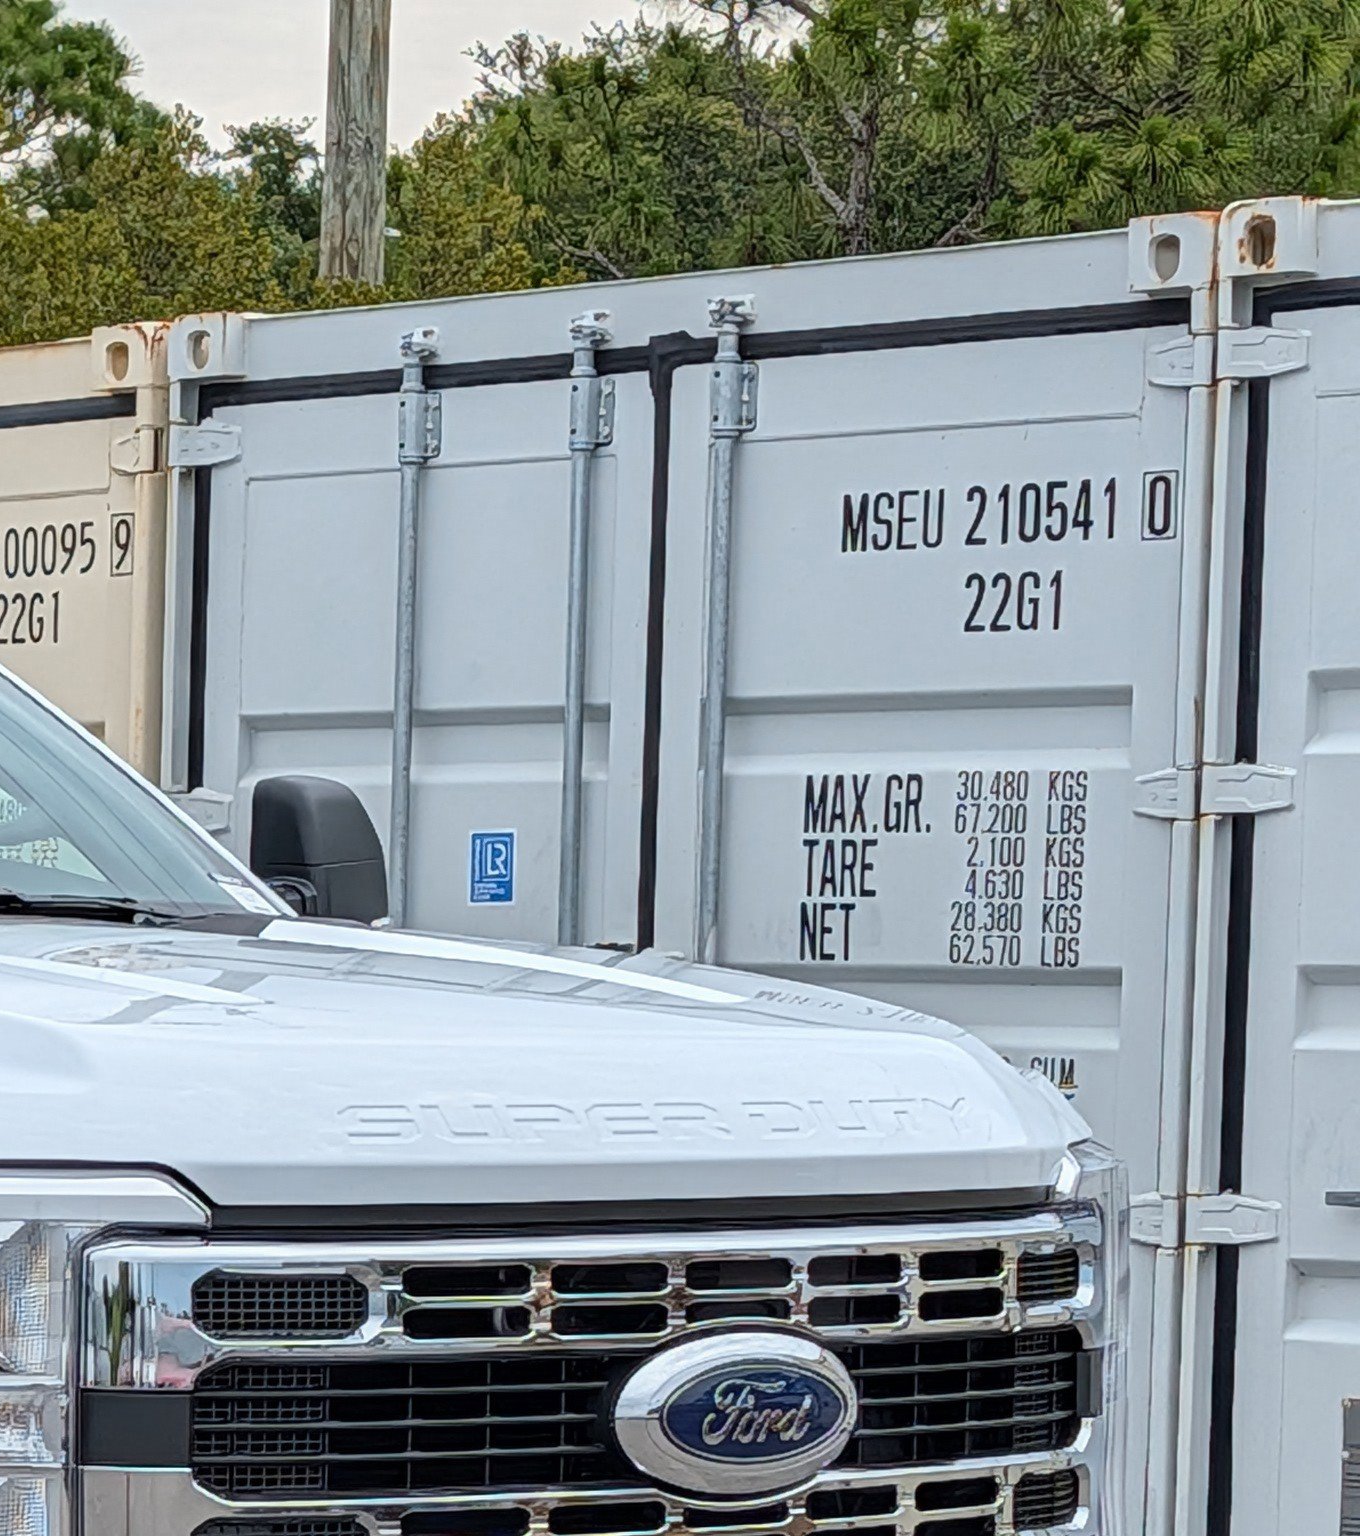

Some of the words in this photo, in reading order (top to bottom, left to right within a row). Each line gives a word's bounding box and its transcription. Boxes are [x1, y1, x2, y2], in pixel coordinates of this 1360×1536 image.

[841, 488, 945, 552] MSEU
[964, 477, 1117, 546] 210541
[1146, 474, 1173, 538] 0
[112, 516, 133, 573] 9
[963, 570, 1063, 633] 22G1
[1047, 770, 1088, 802] KGS
[1046, 803, 1086, 835] LBS
[802, 838, 879, 898] TARE
[1044, 836, 1085, 868] KGS
[1043, 869, 1083, 901] LBS
[799, 902, 857, 962] NET
[1041, 903, 1082, 934] KGS
[1040, 935, 1080, 968] LBS
[336, 1100, 733, 1146] SUPER
[738, 1096, 967, 1142] DUTY
[701, 1378, 812, 1446] Ford
